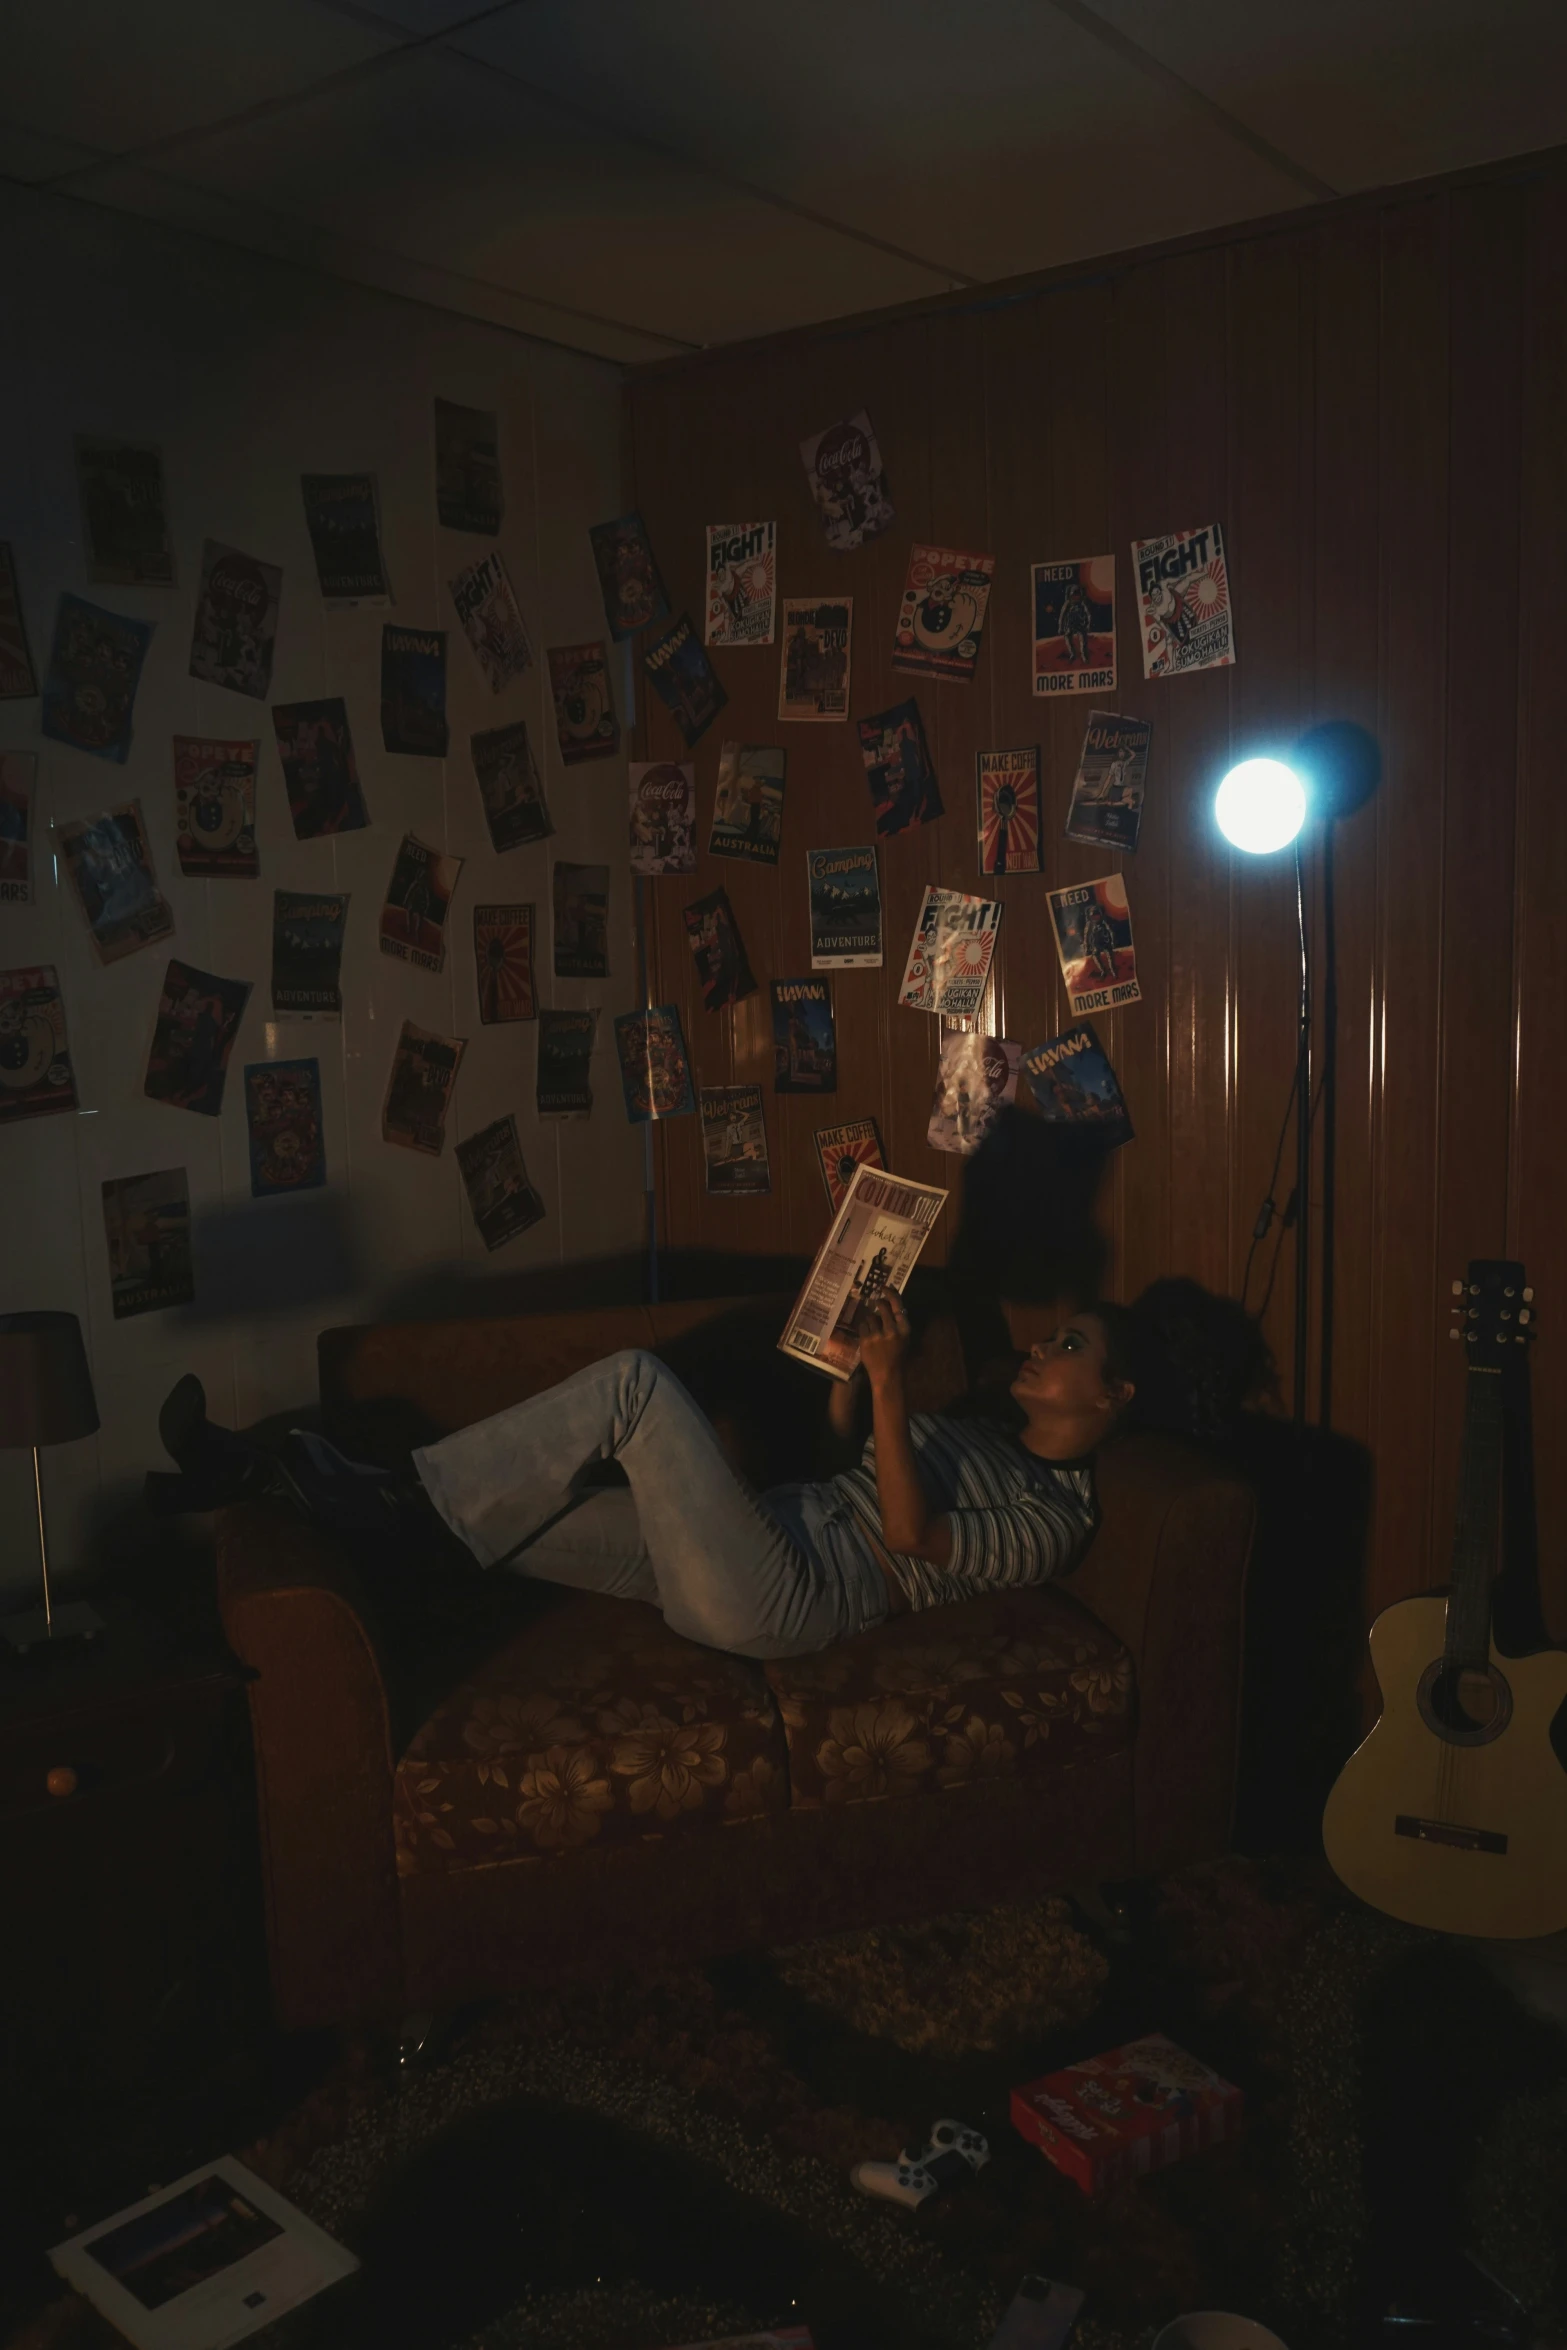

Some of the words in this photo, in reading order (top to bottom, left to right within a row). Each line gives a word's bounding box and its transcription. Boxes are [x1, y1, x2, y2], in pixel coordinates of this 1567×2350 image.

[710, 521, 774, 572] FIGHT!
[1139, 542, 1162, 559] ROUND
[914, 549, 995, 573] POPEYE
[1139, 523, 1222, 594] FIGHT!
[1043, 566, 1073, 583] NEED
[824, 629, 847, 649] DEVO
[1176, 627, 1228, 658] KOKUGIKAN
[1175, 653, 1202, 672] SUMO
[1036, 674, 1074, 692] MORE
[1079, 671, 1114, 688] MARS
[982, 754, 1009, 773] MAKE
[713, 836, 776, 857] AUSTRALIA
[812, 853, 874, 879] Camping
[1060, 889, 1090, 908] NEED
[816, 935, 877, 949] ADVENTURE
[381, 937, 408, 960] MORE
[411, 950, 438, 972] MARS
[276, 989, 336, 1003] ADVENTURE
[1074, 991, 1110, 1012] MORE
[1112, 982, 1140, 1003] MARS
[818, 1126, 845, 1149] MAKE
[855, 1177, 918, 1218] COUNTRY
[117, 1284, 190, 1307] AUSTRALIA
